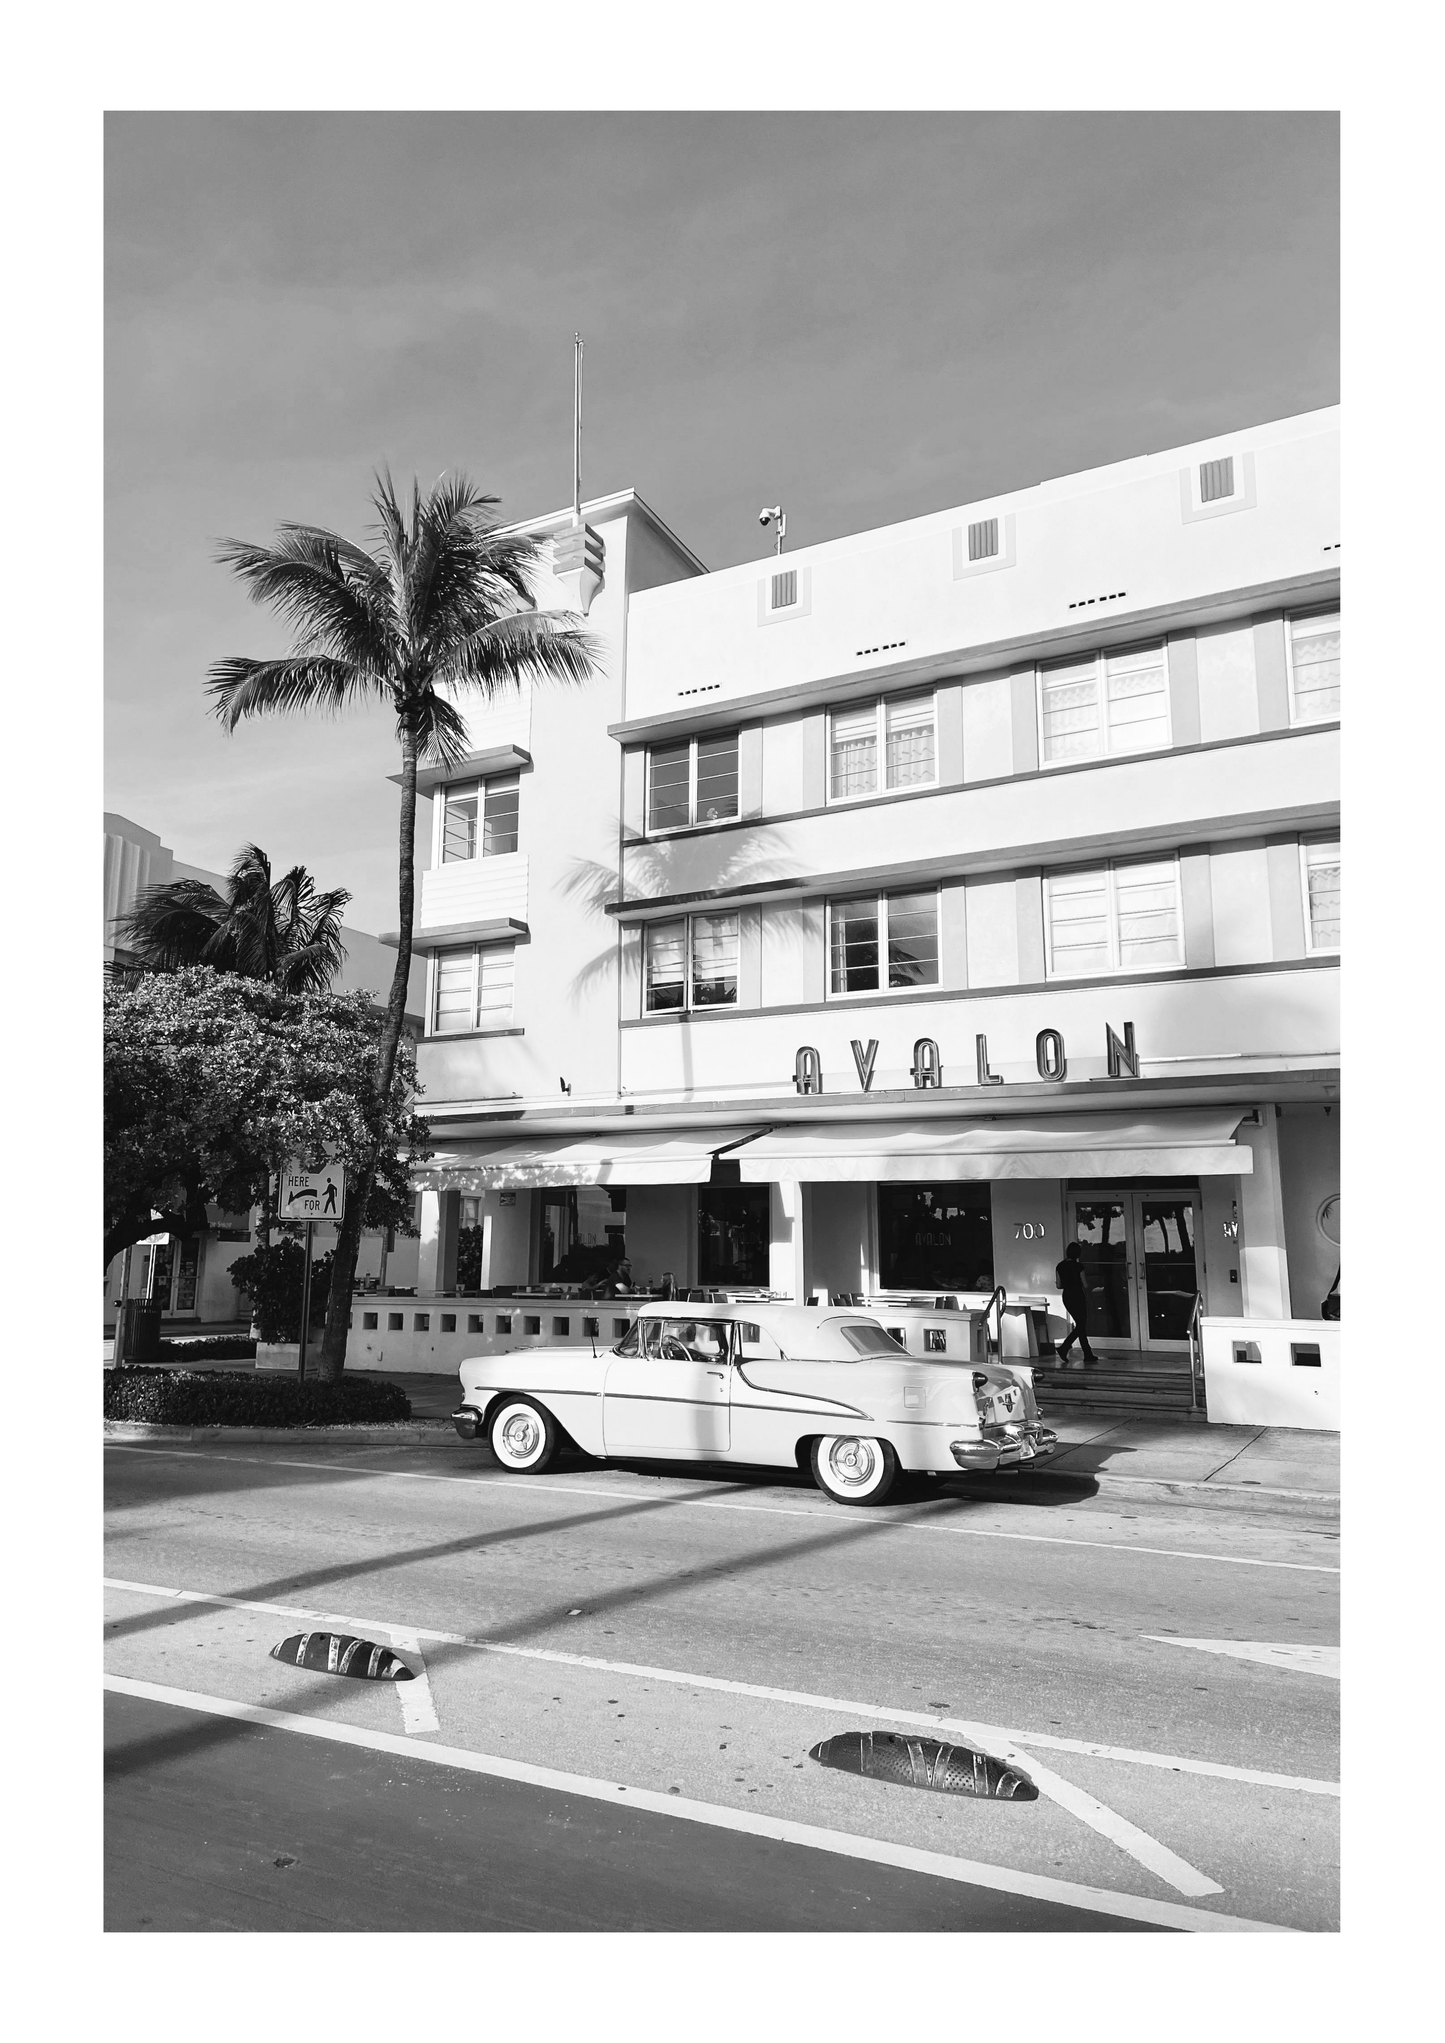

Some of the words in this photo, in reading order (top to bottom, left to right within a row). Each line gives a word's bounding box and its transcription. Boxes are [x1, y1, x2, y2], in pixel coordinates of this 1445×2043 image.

[793, 1021, 1140, 1095] AVALON
[288, 1176, 310, 1188] HERE
[304, 1200, 321, 1211] FOR
[1013, 1222, 1046, 1240] 700
[915, 1232, 952, 1246] AVALON
